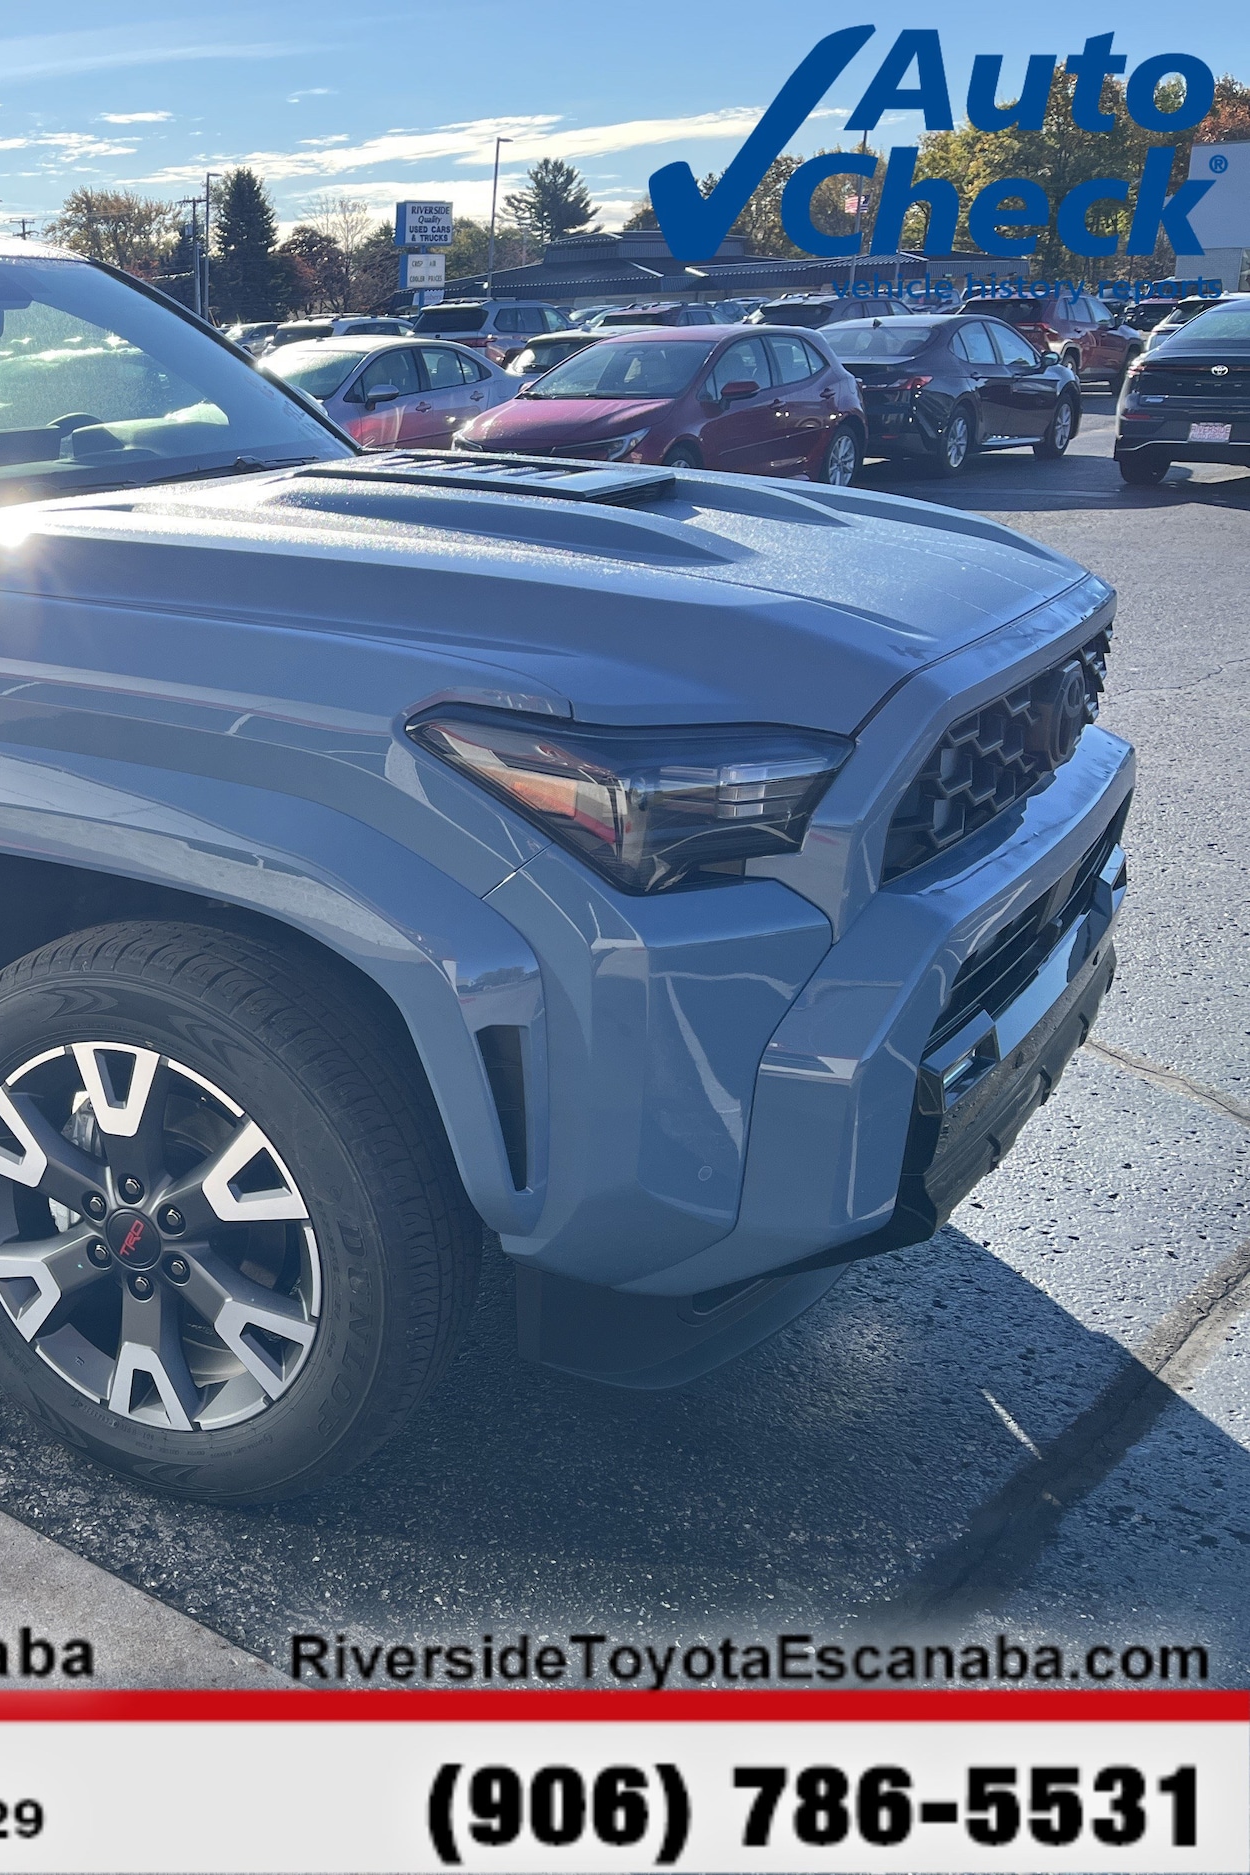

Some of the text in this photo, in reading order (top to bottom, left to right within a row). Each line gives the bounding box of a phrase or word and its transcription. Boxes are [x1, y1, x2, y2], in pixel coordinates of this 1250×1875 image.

[411, 205, 450, 214] RIVERSIDE
[418, 215, 442, 225] Quality
[409, 225, 451, 233] USED CARS
[411, 234, 448, 242] & TRUCKS
[120, 1219, 144, 1256] TRD
[317, 1219, 372, 1437] DUNLOP
